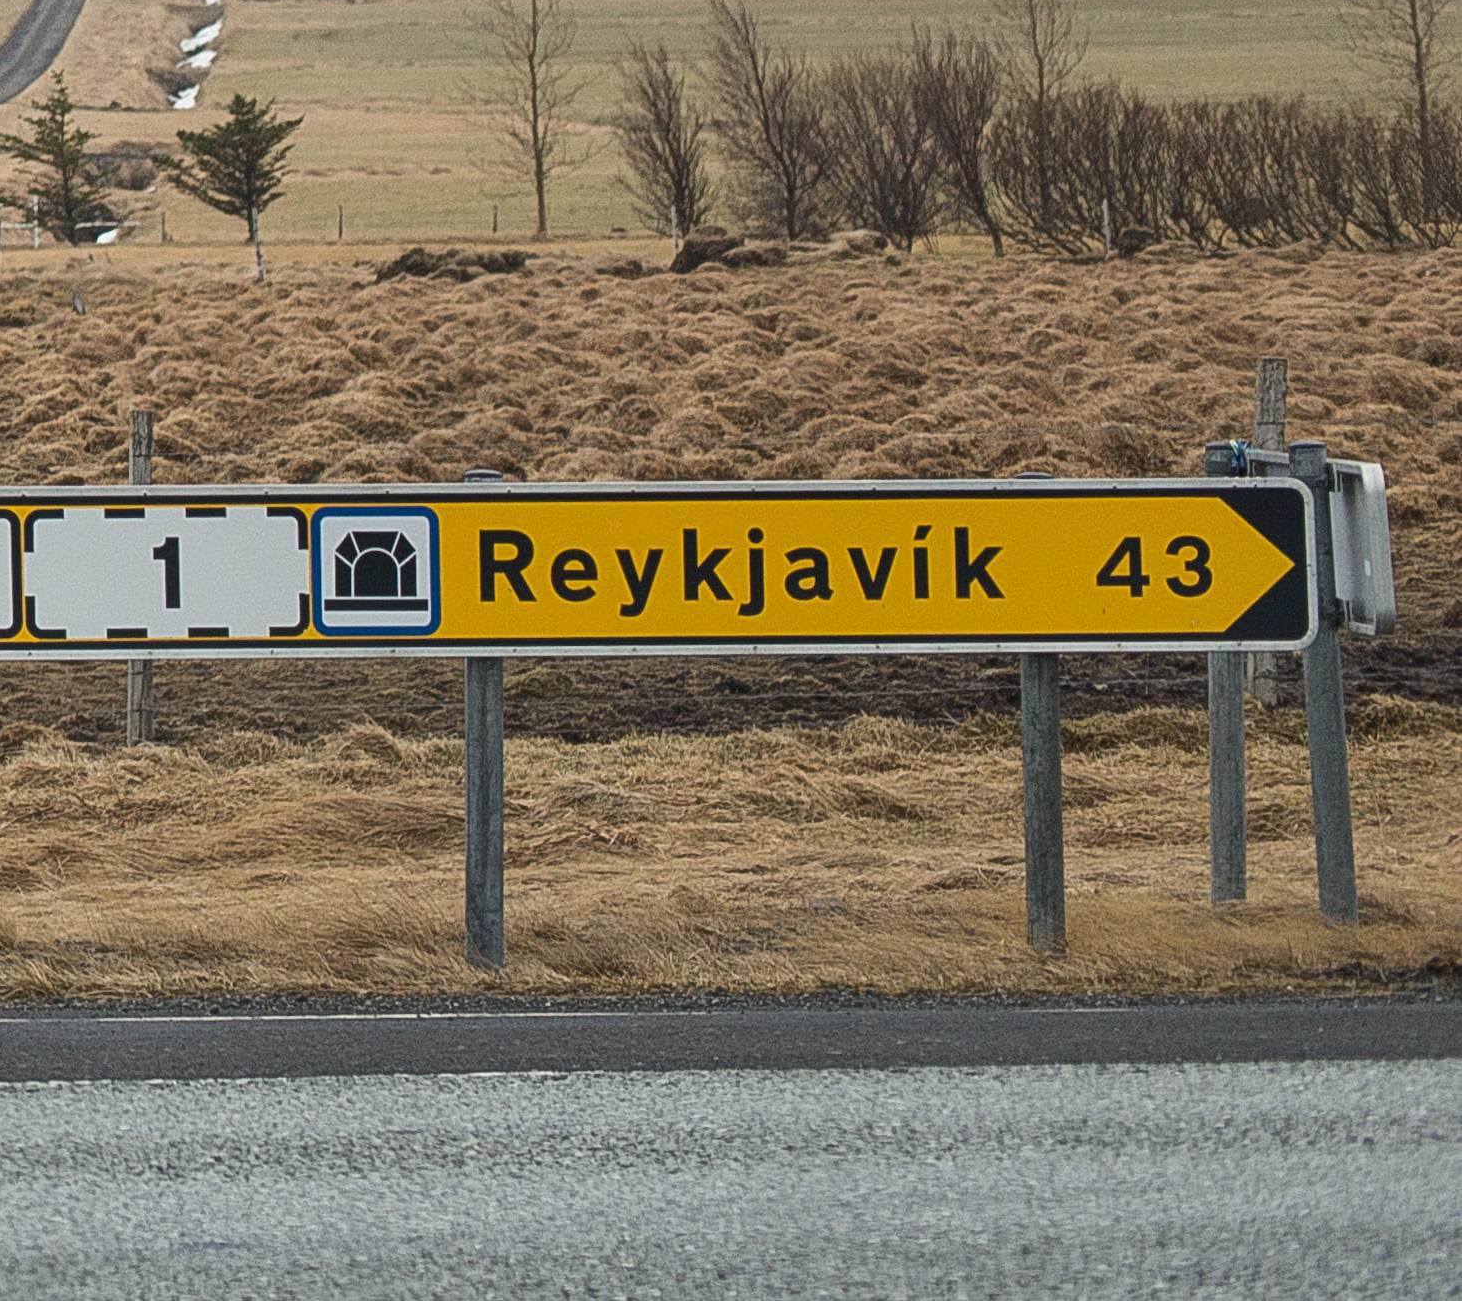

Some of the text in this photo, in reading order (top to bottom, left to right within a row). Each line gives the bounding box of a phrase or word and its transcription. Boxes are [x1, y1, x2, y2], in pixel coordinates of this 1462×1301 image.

[153, 537, 182, 610] 1
[479, 525, 1006, 617] Reykjavík
[1096, 535, 1213, 598] 43
